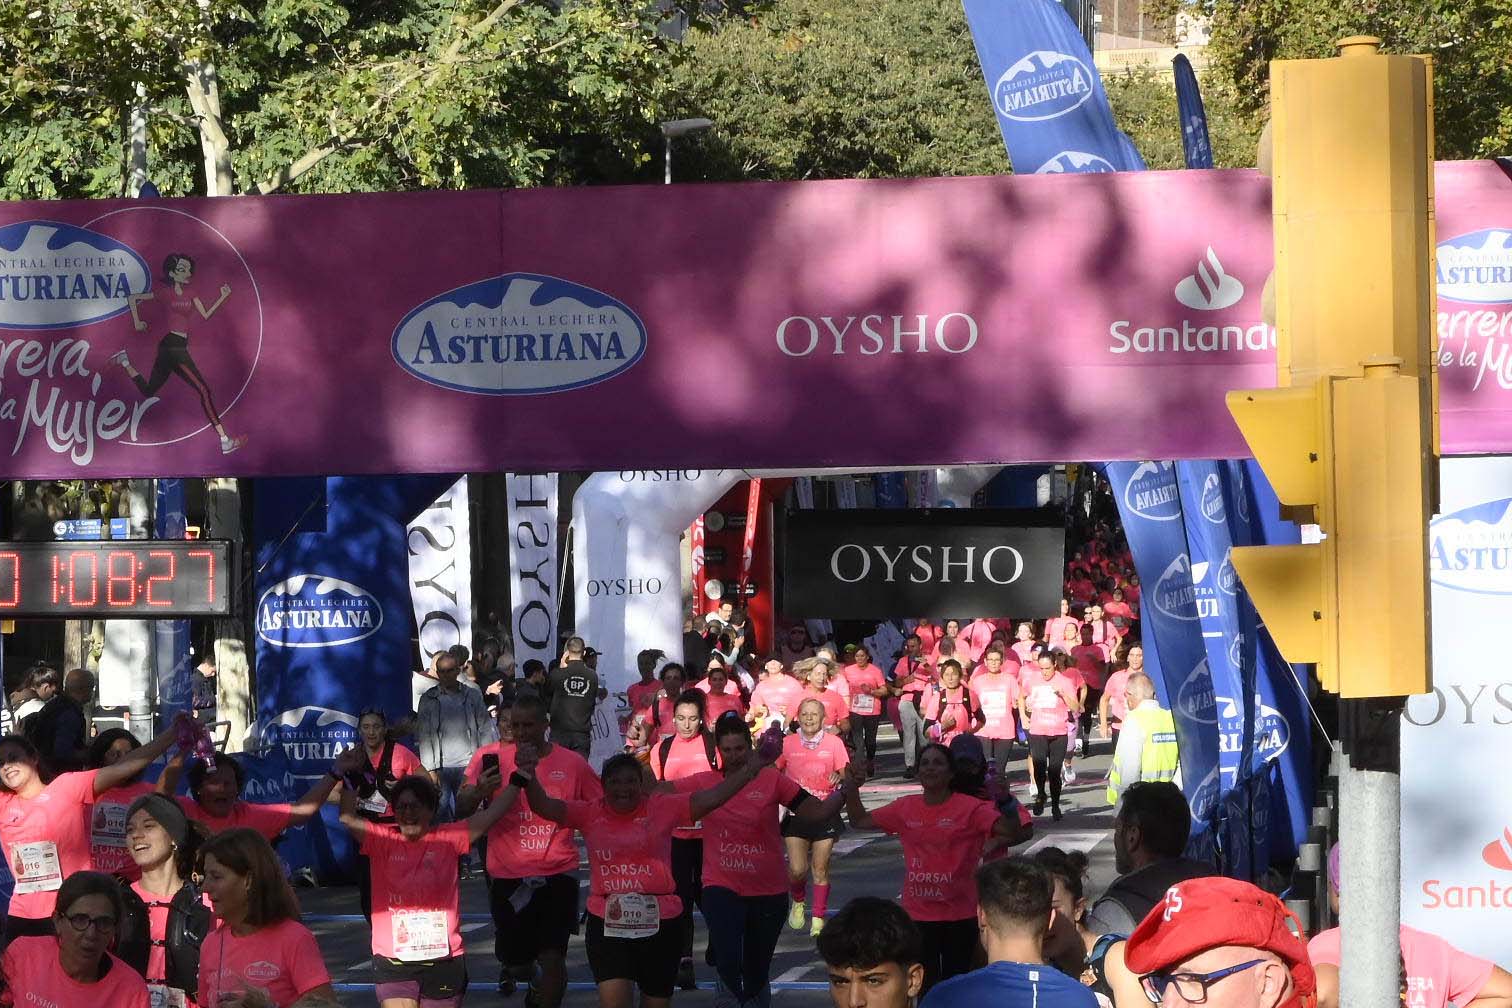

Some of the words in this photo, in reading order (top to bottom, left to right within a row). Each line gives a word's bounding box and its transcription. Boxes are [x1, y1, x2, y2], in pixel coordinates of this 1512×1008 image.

[54, 256, 127, 268] LECHERA
[450, 315, 529, 329] CENTRAL
[538, 313, 619, 327] LECHERA
[1436, 310, 1512, 338] arrer
[411, 320, 627, 365] ASTURIANA
[775, 313, 978, 357] OYSHO
[12, 373, 160, 466] Mujer
[830, 544, 1024, 585] OYSHO
[586, 577, 663, 597] OYSHO
[273, 599, 316, 608] CENTRAL
[320, 599, 370, 607] LECHERA
[260, 600, 374, 631] ASTURIANA
[25, 861, 40, 870] 016
[600, 863, 653, 877] DORSAL
[603, 879, 643, 892] SUMA
